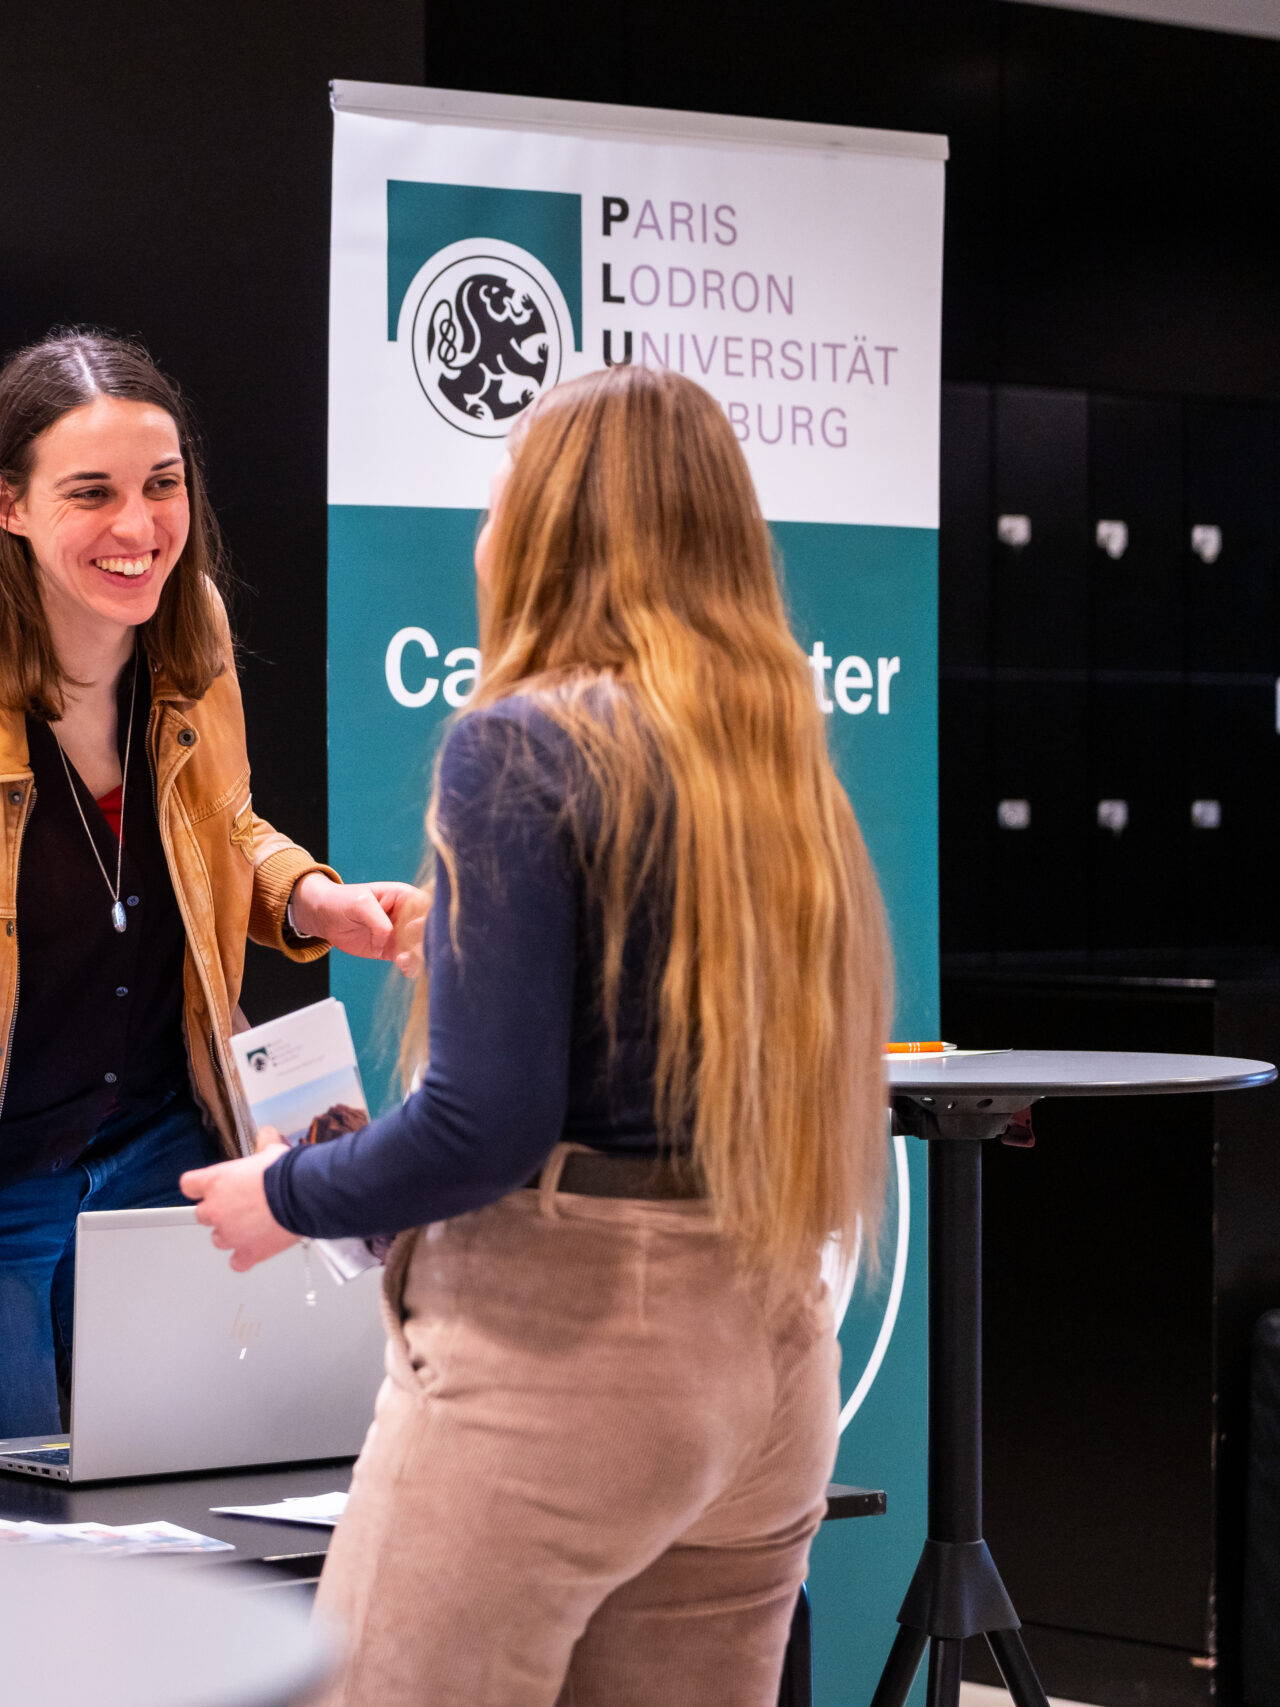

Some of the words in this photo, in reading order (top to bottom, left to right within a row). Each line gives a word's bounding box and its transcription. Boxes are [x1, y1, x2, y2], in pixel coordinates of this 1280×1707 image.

[602, 196, 738, 246] PARIS
[602, 262, 795, 315] LODRON
[602, 329, 898, 387] UNIVERSITÄT
[728, 402, 848, 448] BURG
[808, 641, 901, 715] ter
